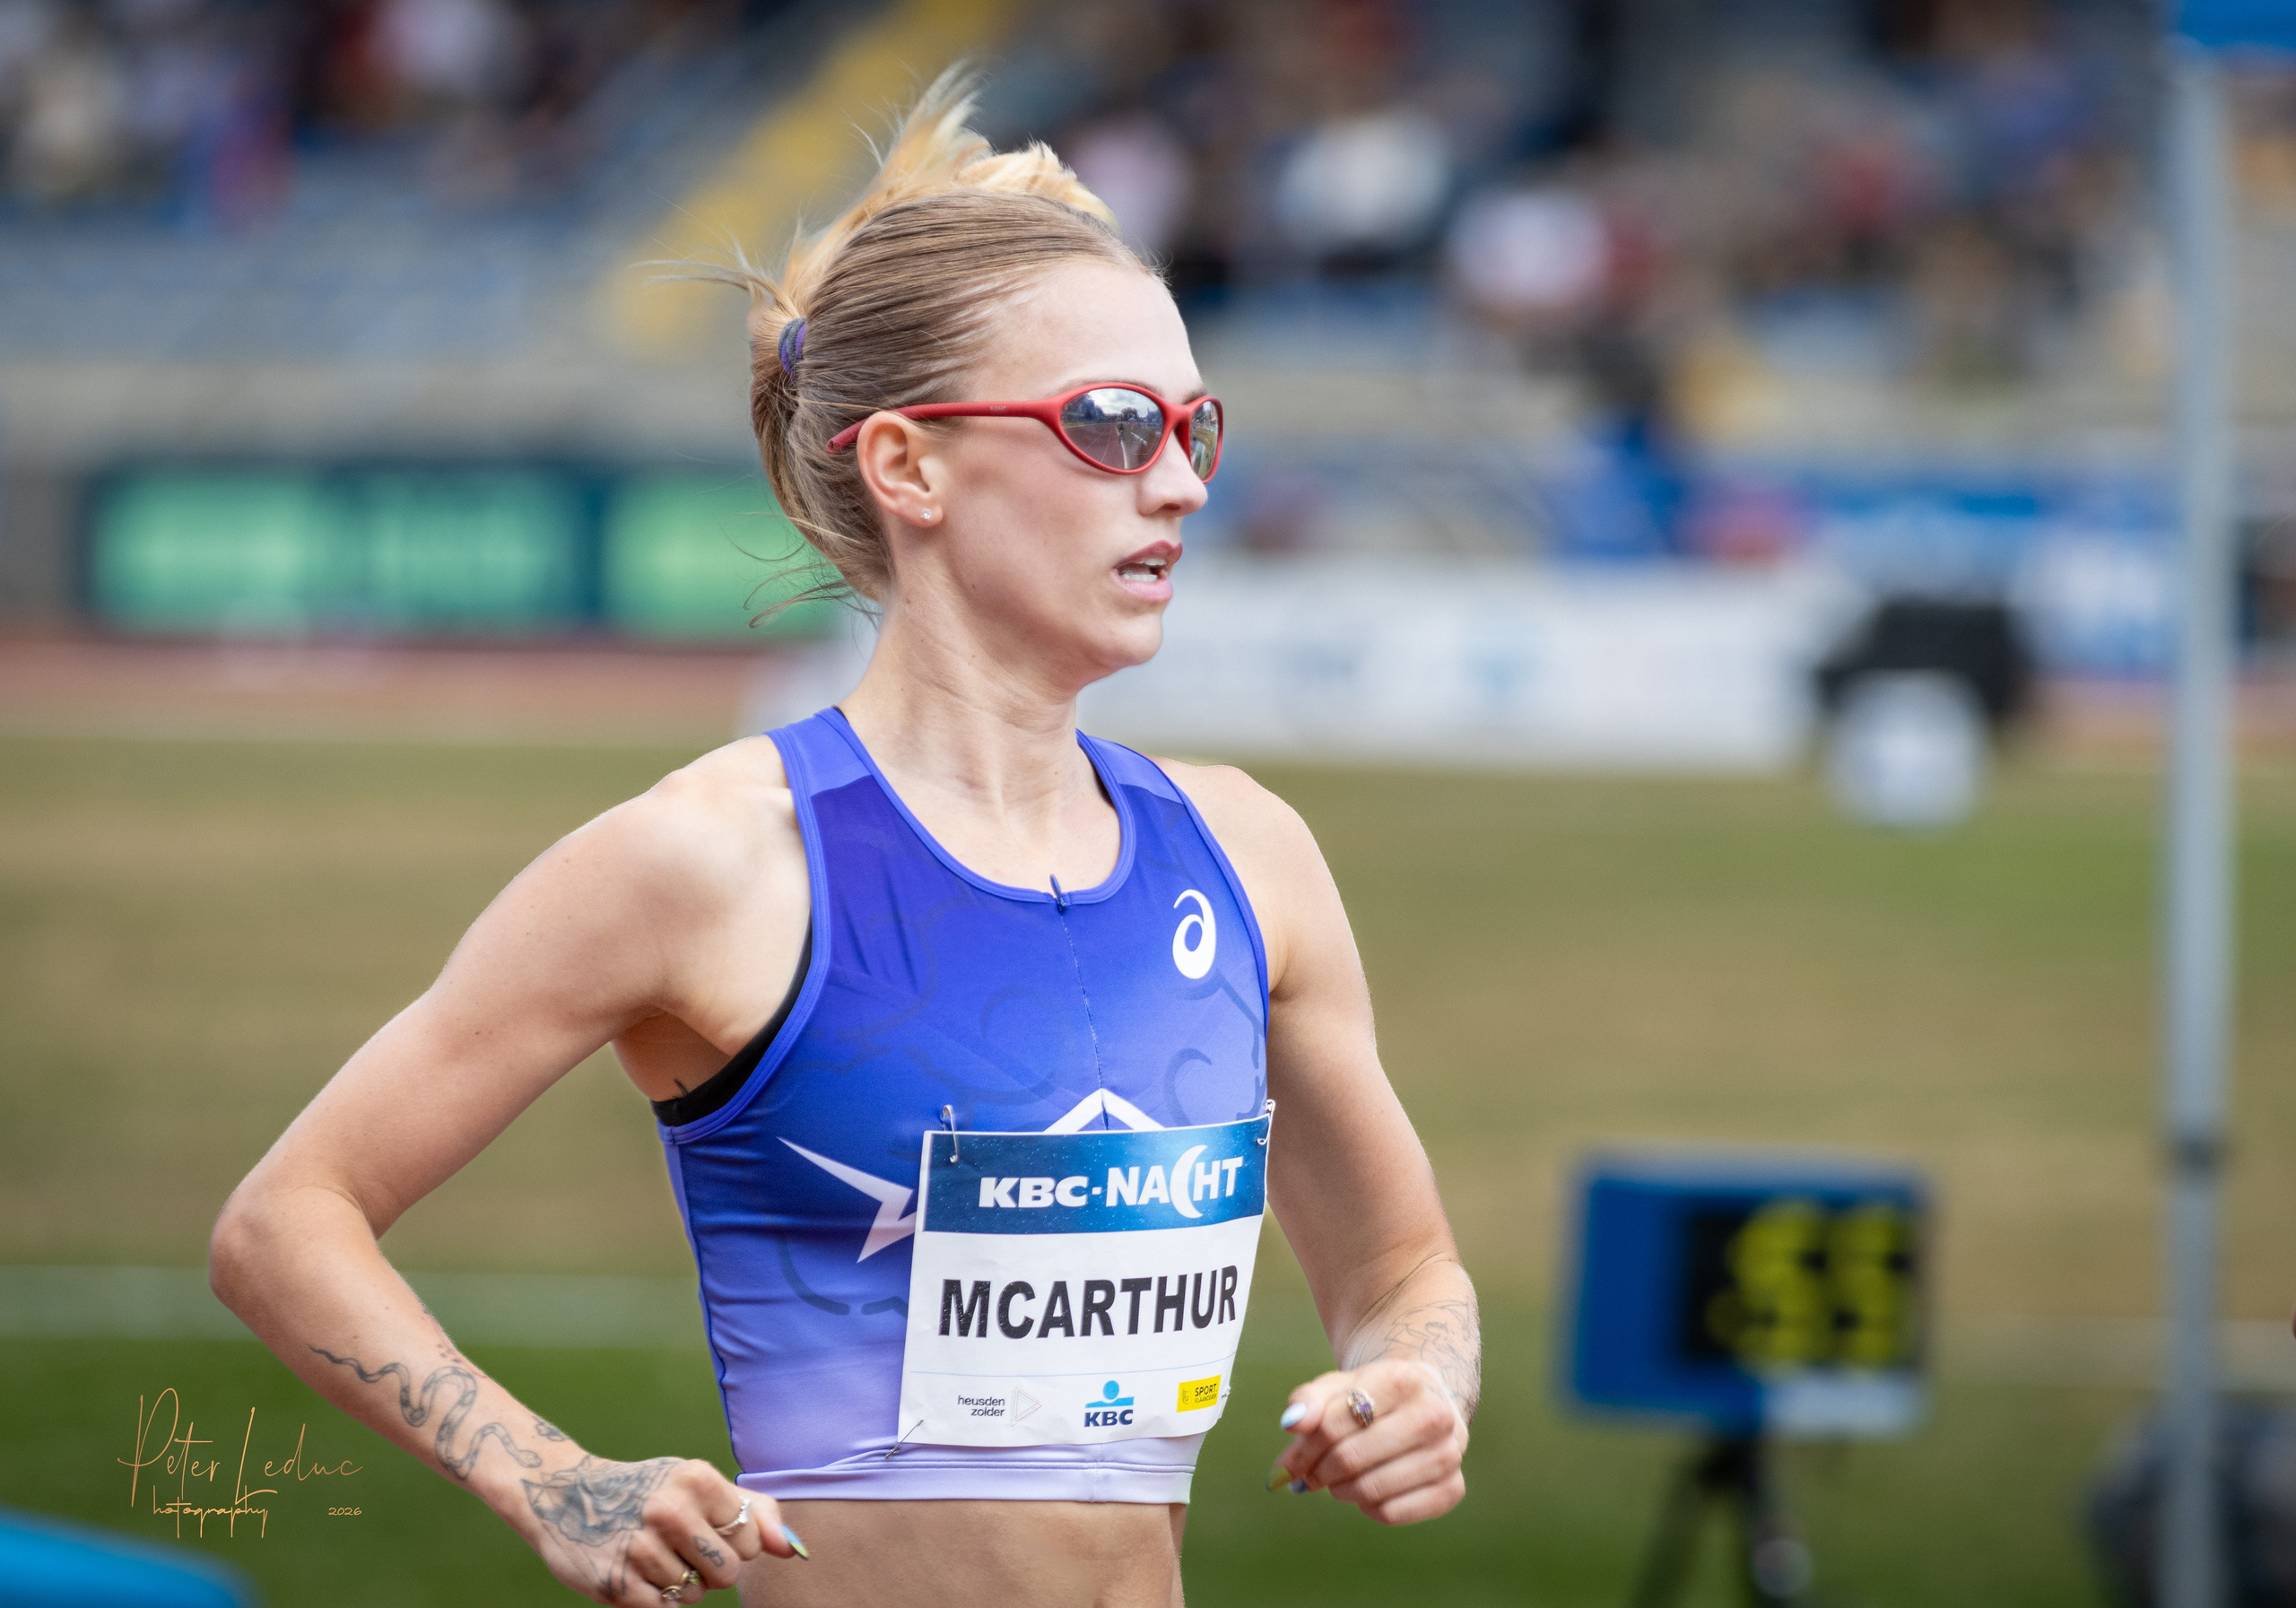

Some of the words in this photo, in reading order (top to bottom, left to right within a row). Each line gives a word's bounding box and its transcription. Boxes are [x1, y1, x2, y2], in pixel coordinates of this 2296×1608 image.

[939, 1265, 1239, 1340] MCARTHUR
[957, 1395, 1005, 1407] heusden
[970, 1406, 1005, 1417] zolder
[1083, 1409, 1135, 1428] KBC
